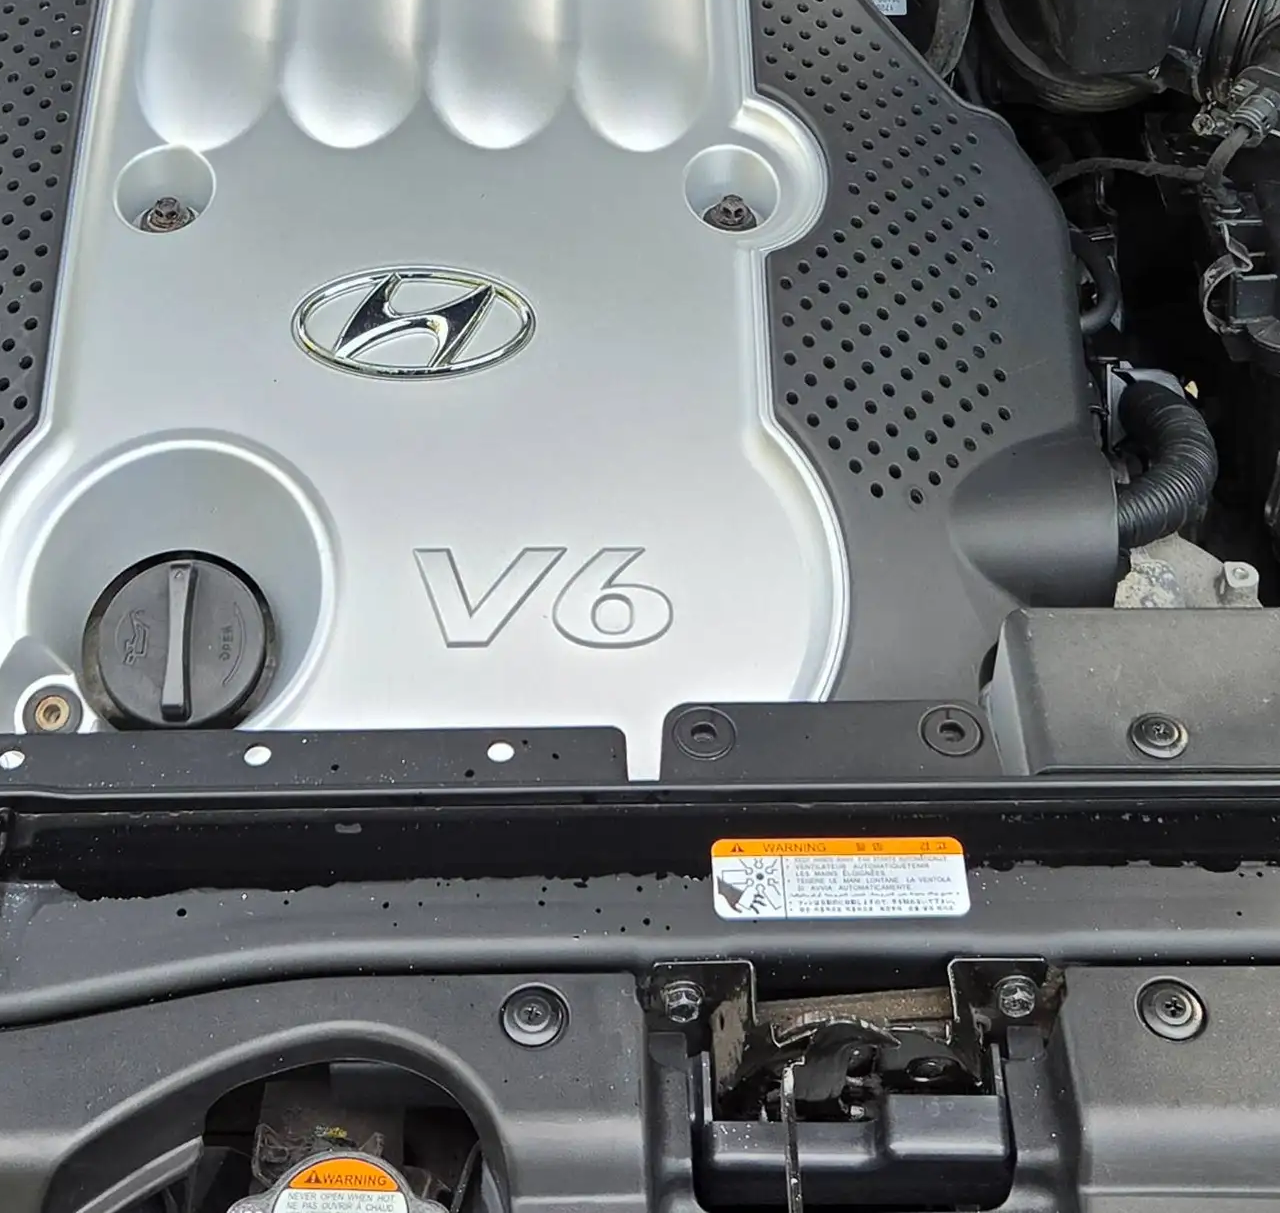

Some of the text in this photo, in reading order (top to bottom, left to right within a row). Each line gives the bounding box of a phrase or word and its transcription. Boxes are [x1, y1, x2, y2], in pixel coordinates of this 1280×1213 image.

[413, 547, 674, 649] V6
[219, 625, 234, 662] OPEN
[762, 842, 827, 853] WARNING
[323, 1174, 387, 1187] WARNING
[288, 1192, 396, 1203] NEVER OPEN WHEN HOT
[302, 1202, 318, 1210] PAS
